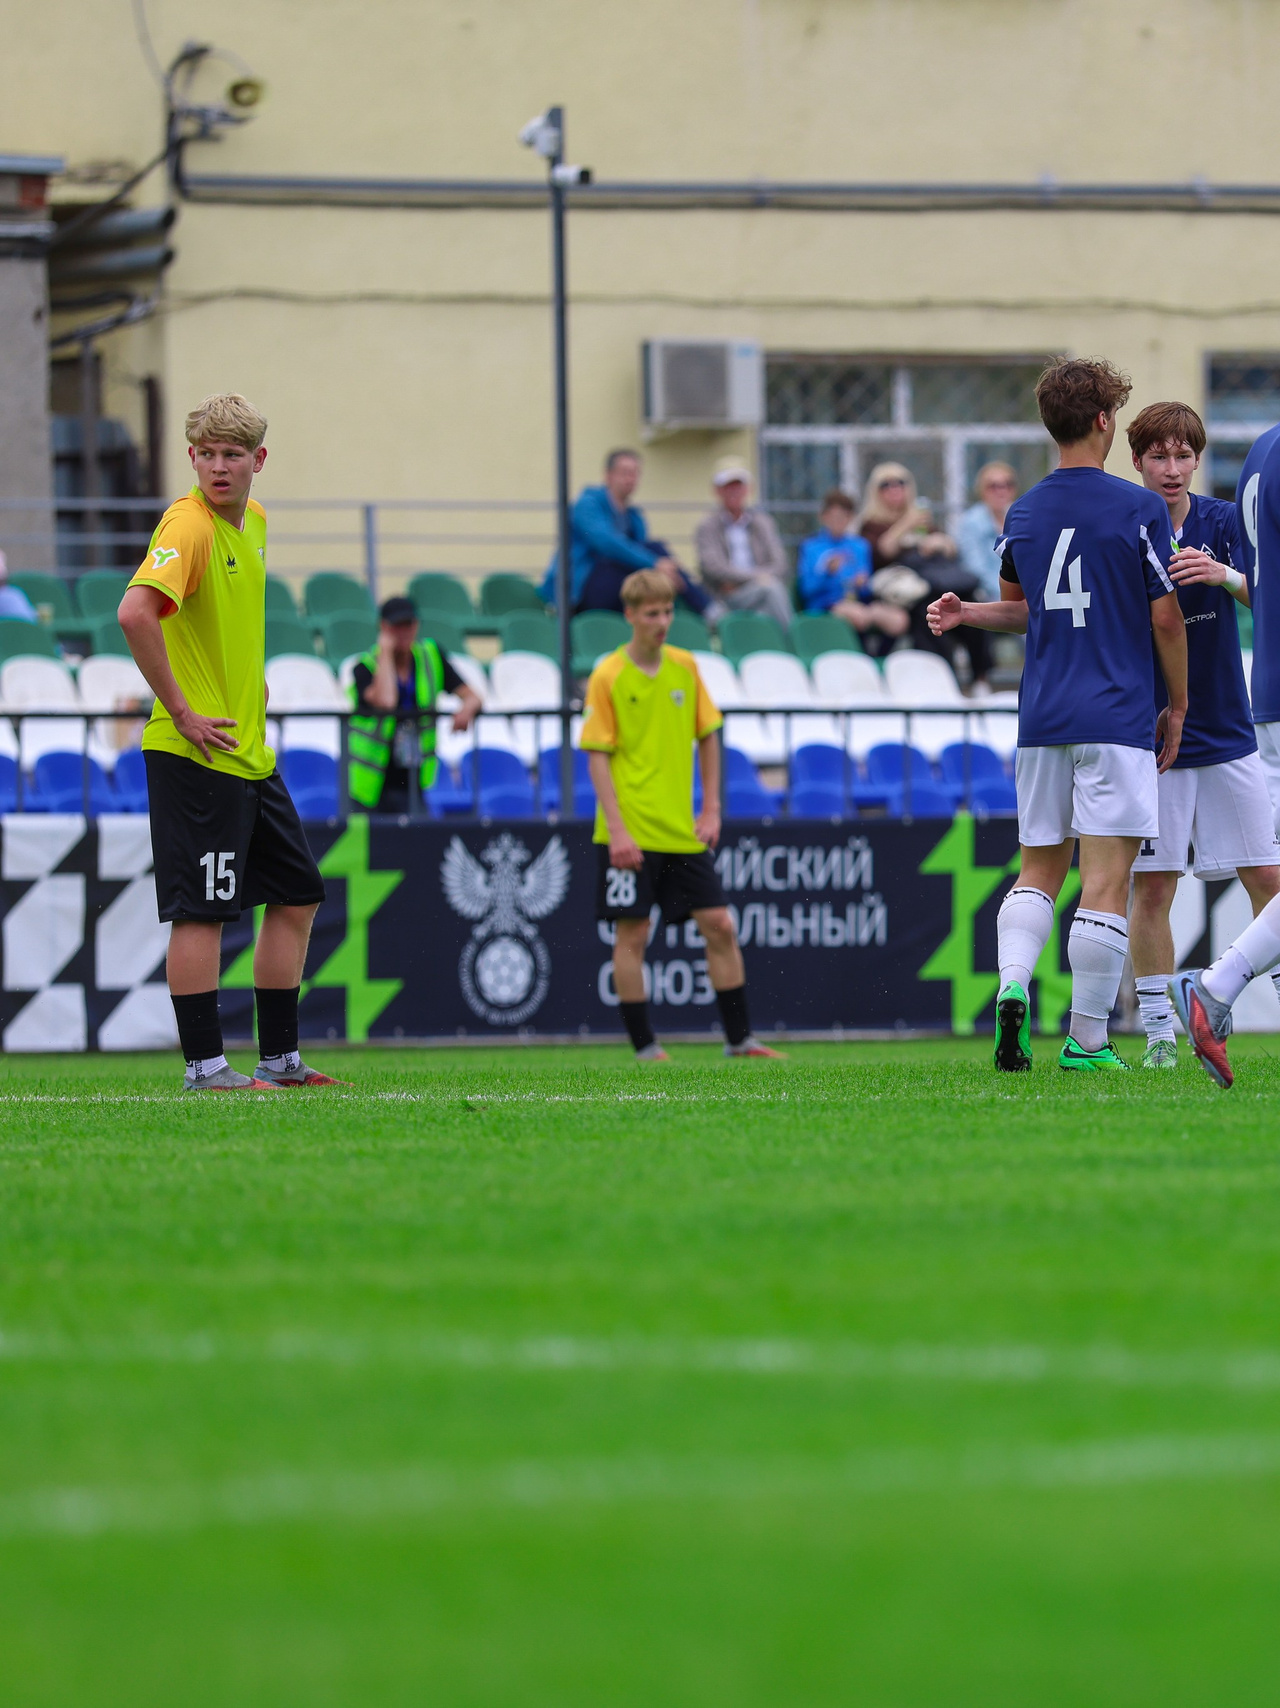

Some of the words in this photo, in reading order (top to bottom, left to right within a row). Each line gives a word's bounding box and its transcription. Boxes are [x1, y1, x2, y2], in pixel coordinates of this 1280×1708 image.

[1044, 528, 1091, 628] 4
[200, 851, 236, 901] 15
[605, 866, 637, 908] 28
